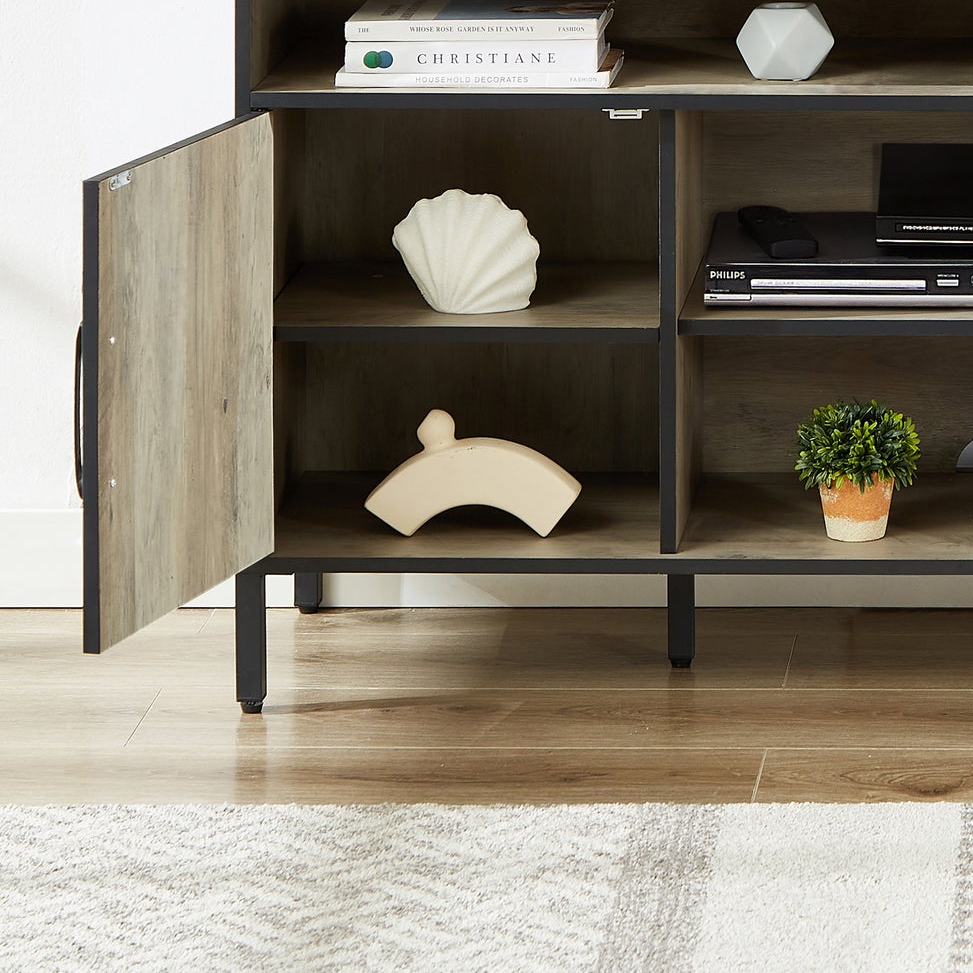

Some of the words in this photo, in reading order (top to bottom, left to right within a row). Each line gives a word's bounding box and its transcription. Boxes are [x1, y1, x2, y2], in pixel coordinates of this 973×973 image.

[417, 53, 556, 65] CHRISTIANE
[415, 76, 471, 84] HOUSEHOLD
[474, 76, 529, 84] DECORATES
[709, 270, 746, 280] PHILIPS
